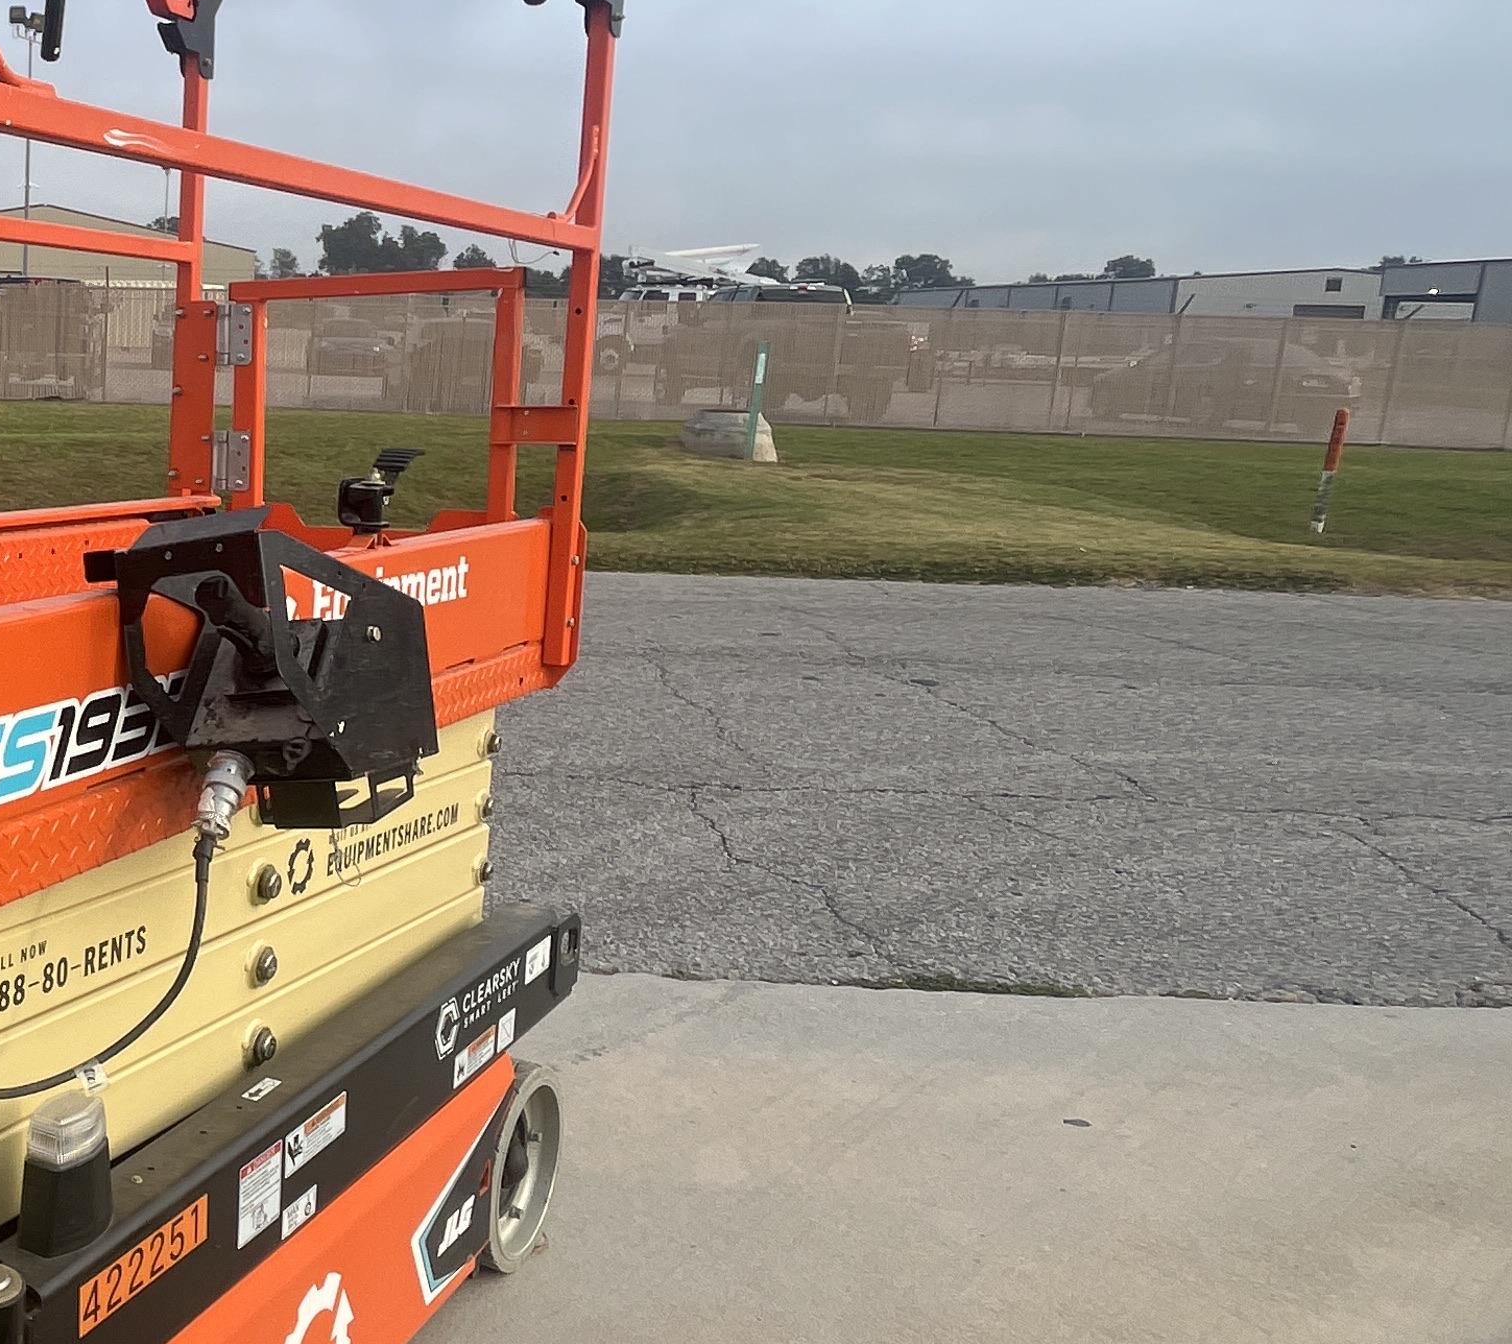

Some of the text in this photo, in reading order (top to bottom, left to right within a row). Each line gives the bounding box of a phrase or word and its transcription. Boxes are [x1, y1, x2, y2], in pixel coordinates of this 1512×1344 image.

[326, 802, 459, 877] EQUIPMENTSHARE.COM
[20, 940, 48, 963] NOW
[462, 957, 522, 1013] CLEARSKY
[463, 1000, 492, 1029] SMART
[437, 1194, 476, 1258] JLG
[82, 1204, 199, 1323] 422251
